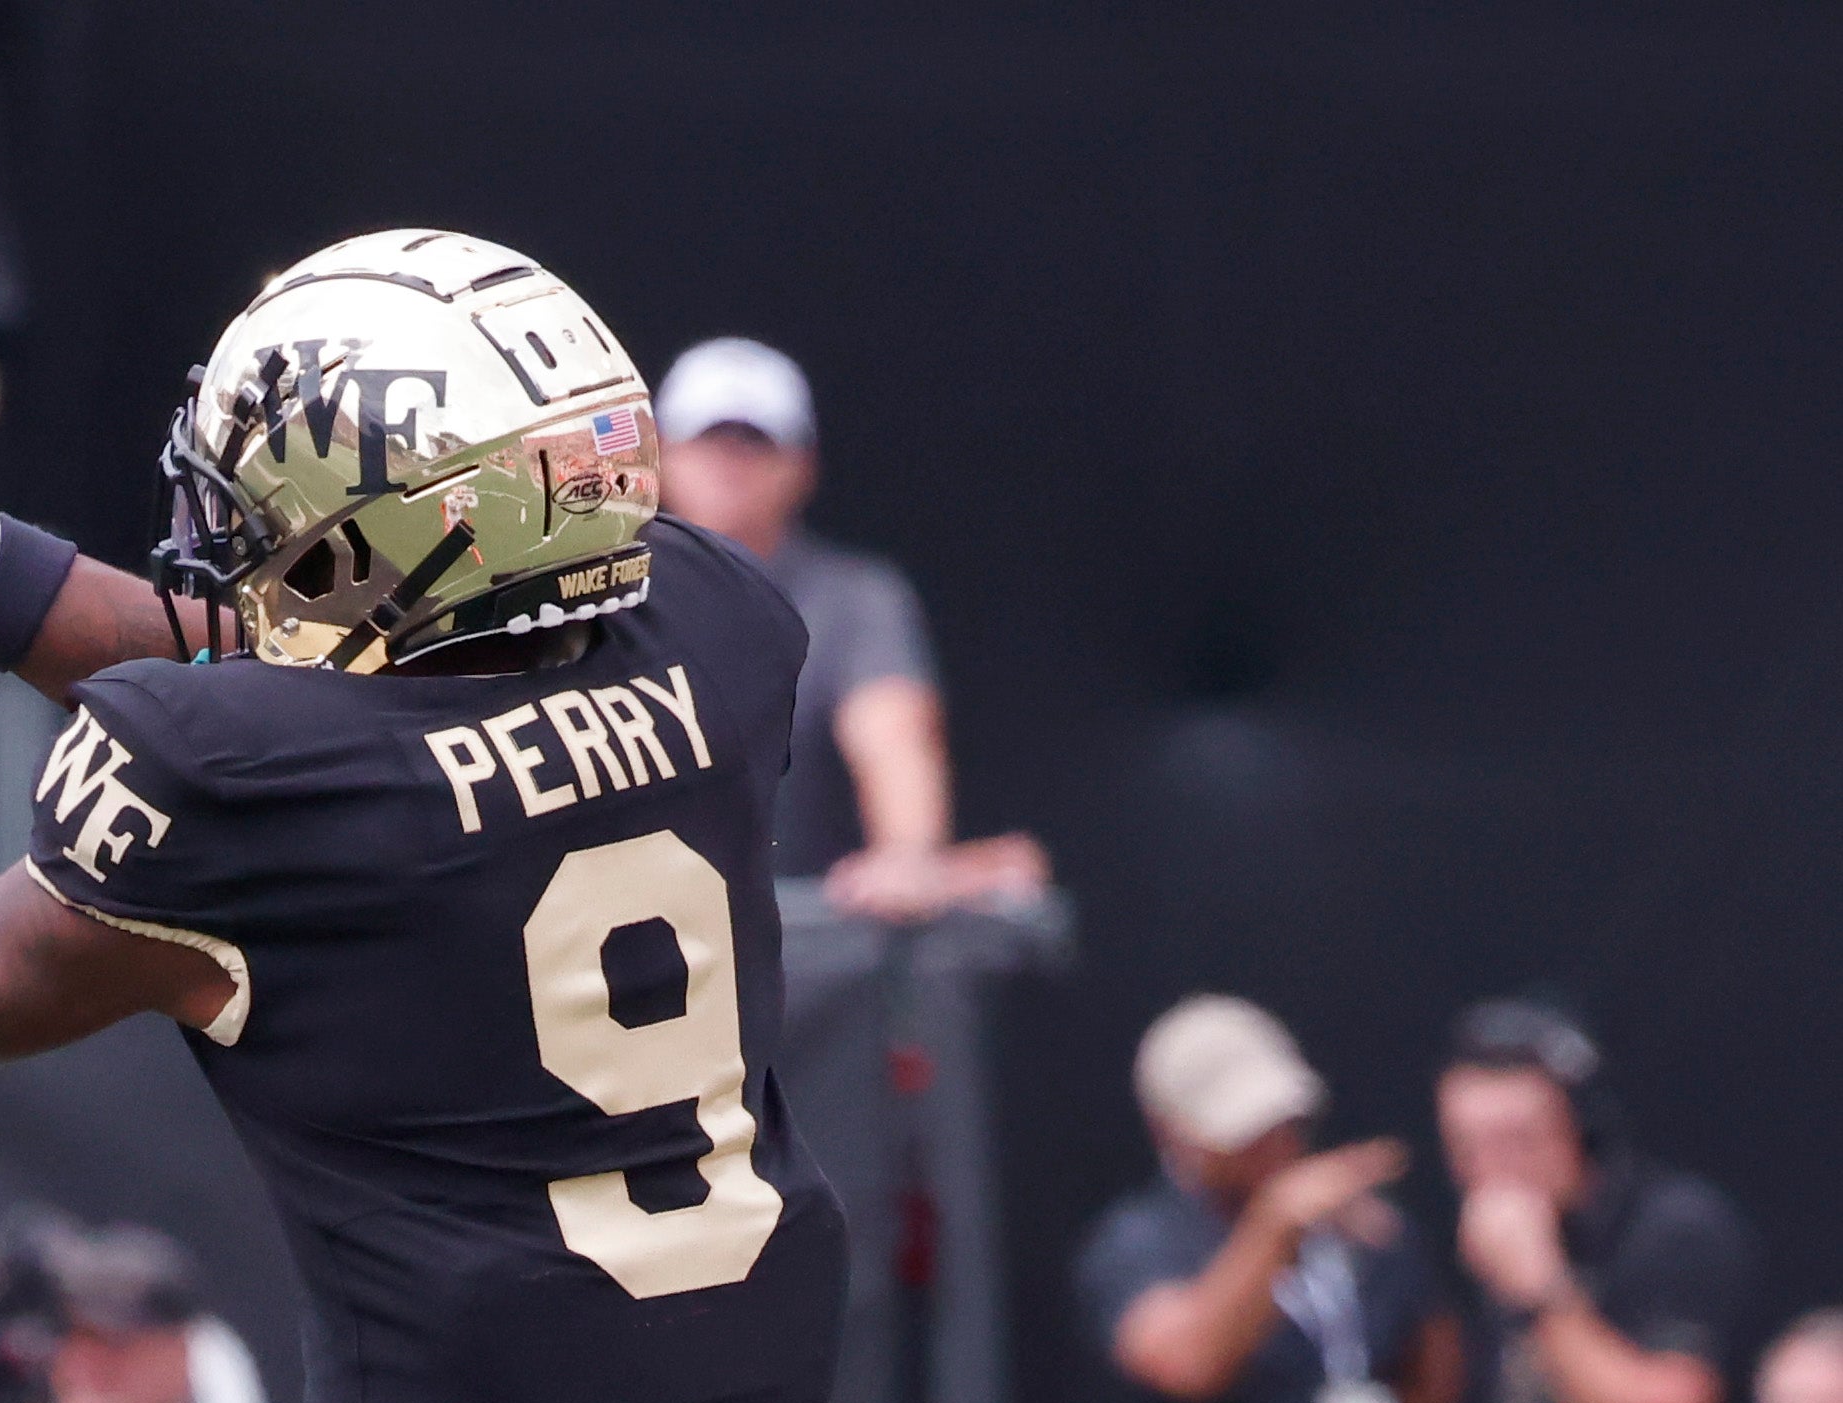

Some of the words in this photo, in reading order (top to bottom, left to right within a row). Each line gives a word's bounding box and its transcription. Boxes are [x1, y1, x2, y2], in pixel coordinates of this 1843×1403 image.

[254, 338, 446, 496] WF
[564, 479, 603, 500] ACC
[558, 565, 609, 600] WAKE
[36, 703, 172, 884] WF
[425, 665, 713, 834] PERRY
[523, 829, 784, 1300] 9
